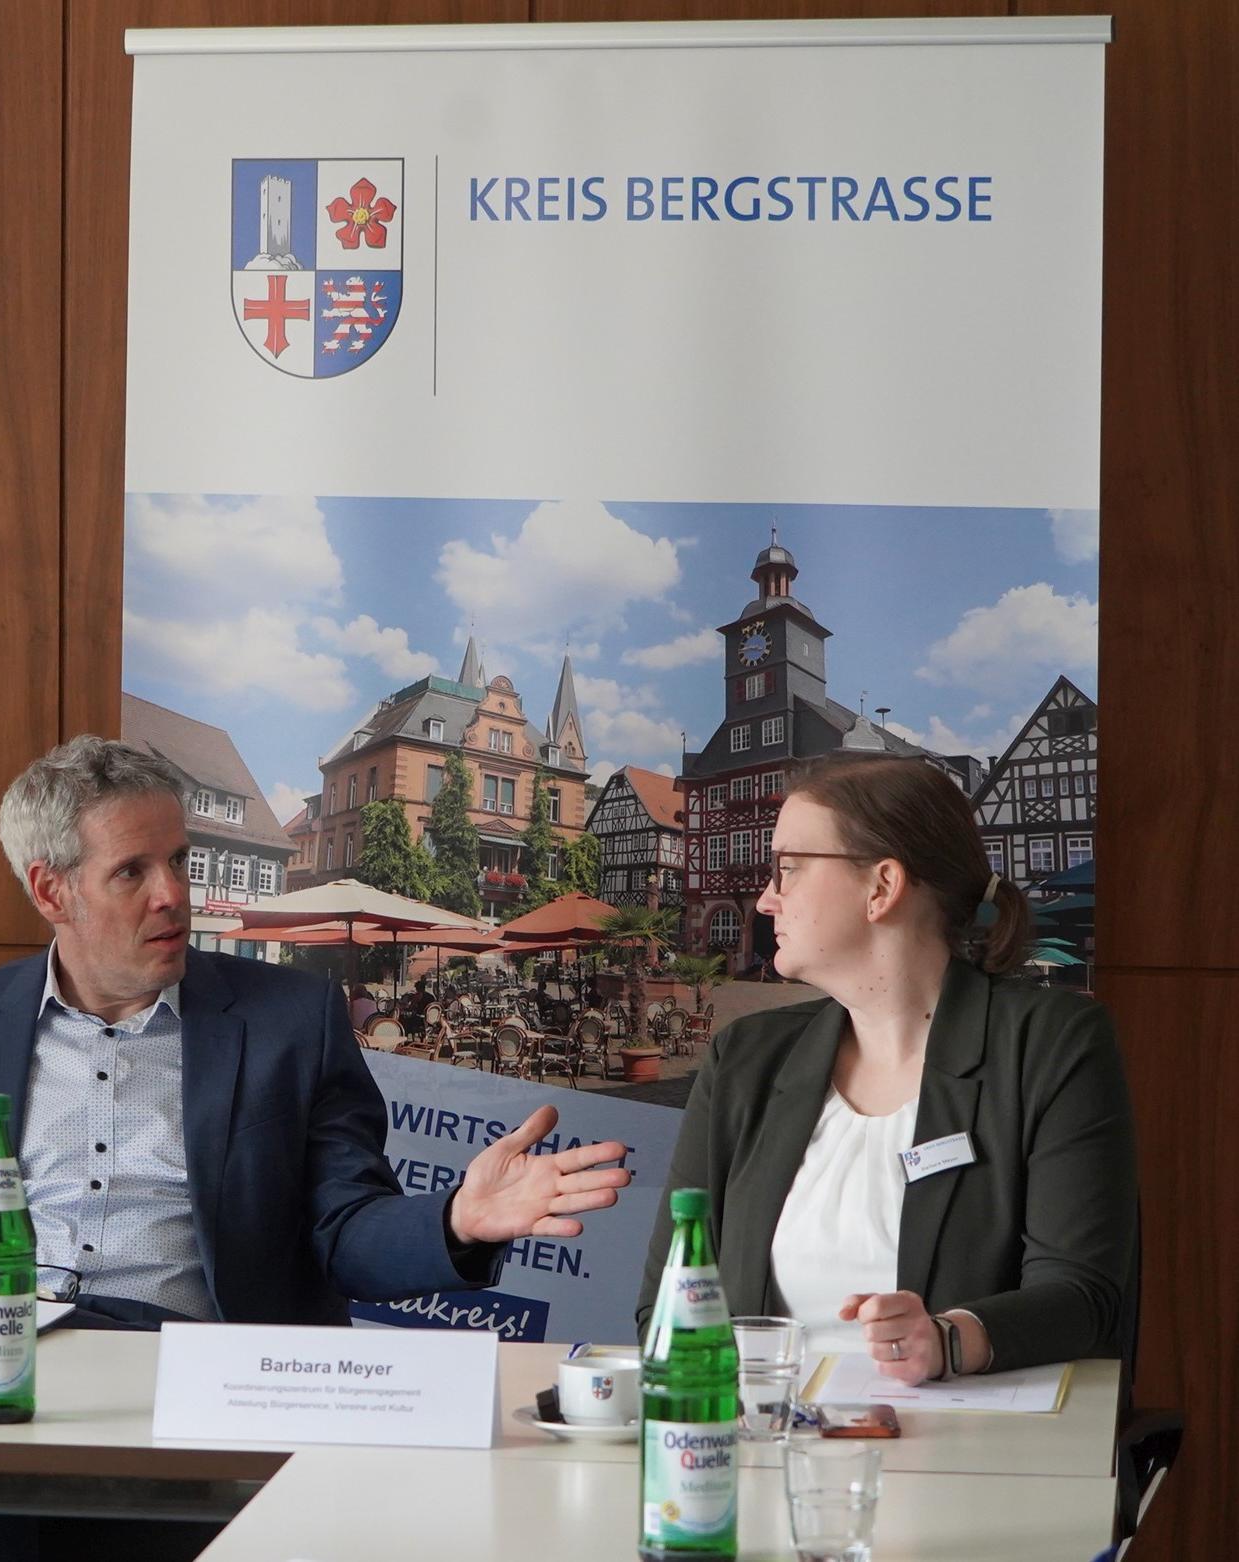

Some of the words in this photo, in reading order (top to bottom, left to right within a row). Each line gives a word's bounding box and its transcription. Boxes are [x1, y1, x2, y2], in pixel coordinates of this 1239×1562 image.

[469, 176, 608, 221] KREIS
[626, 176, 993, 222] BERGSTRASSE
[505, 1238, 590, 1279] HEN.
[260, 1357, 332, 1374] Barbara
[338, 1360, 393, 1378] Meyer
[680, 1450, 731, 1470] Quelle
